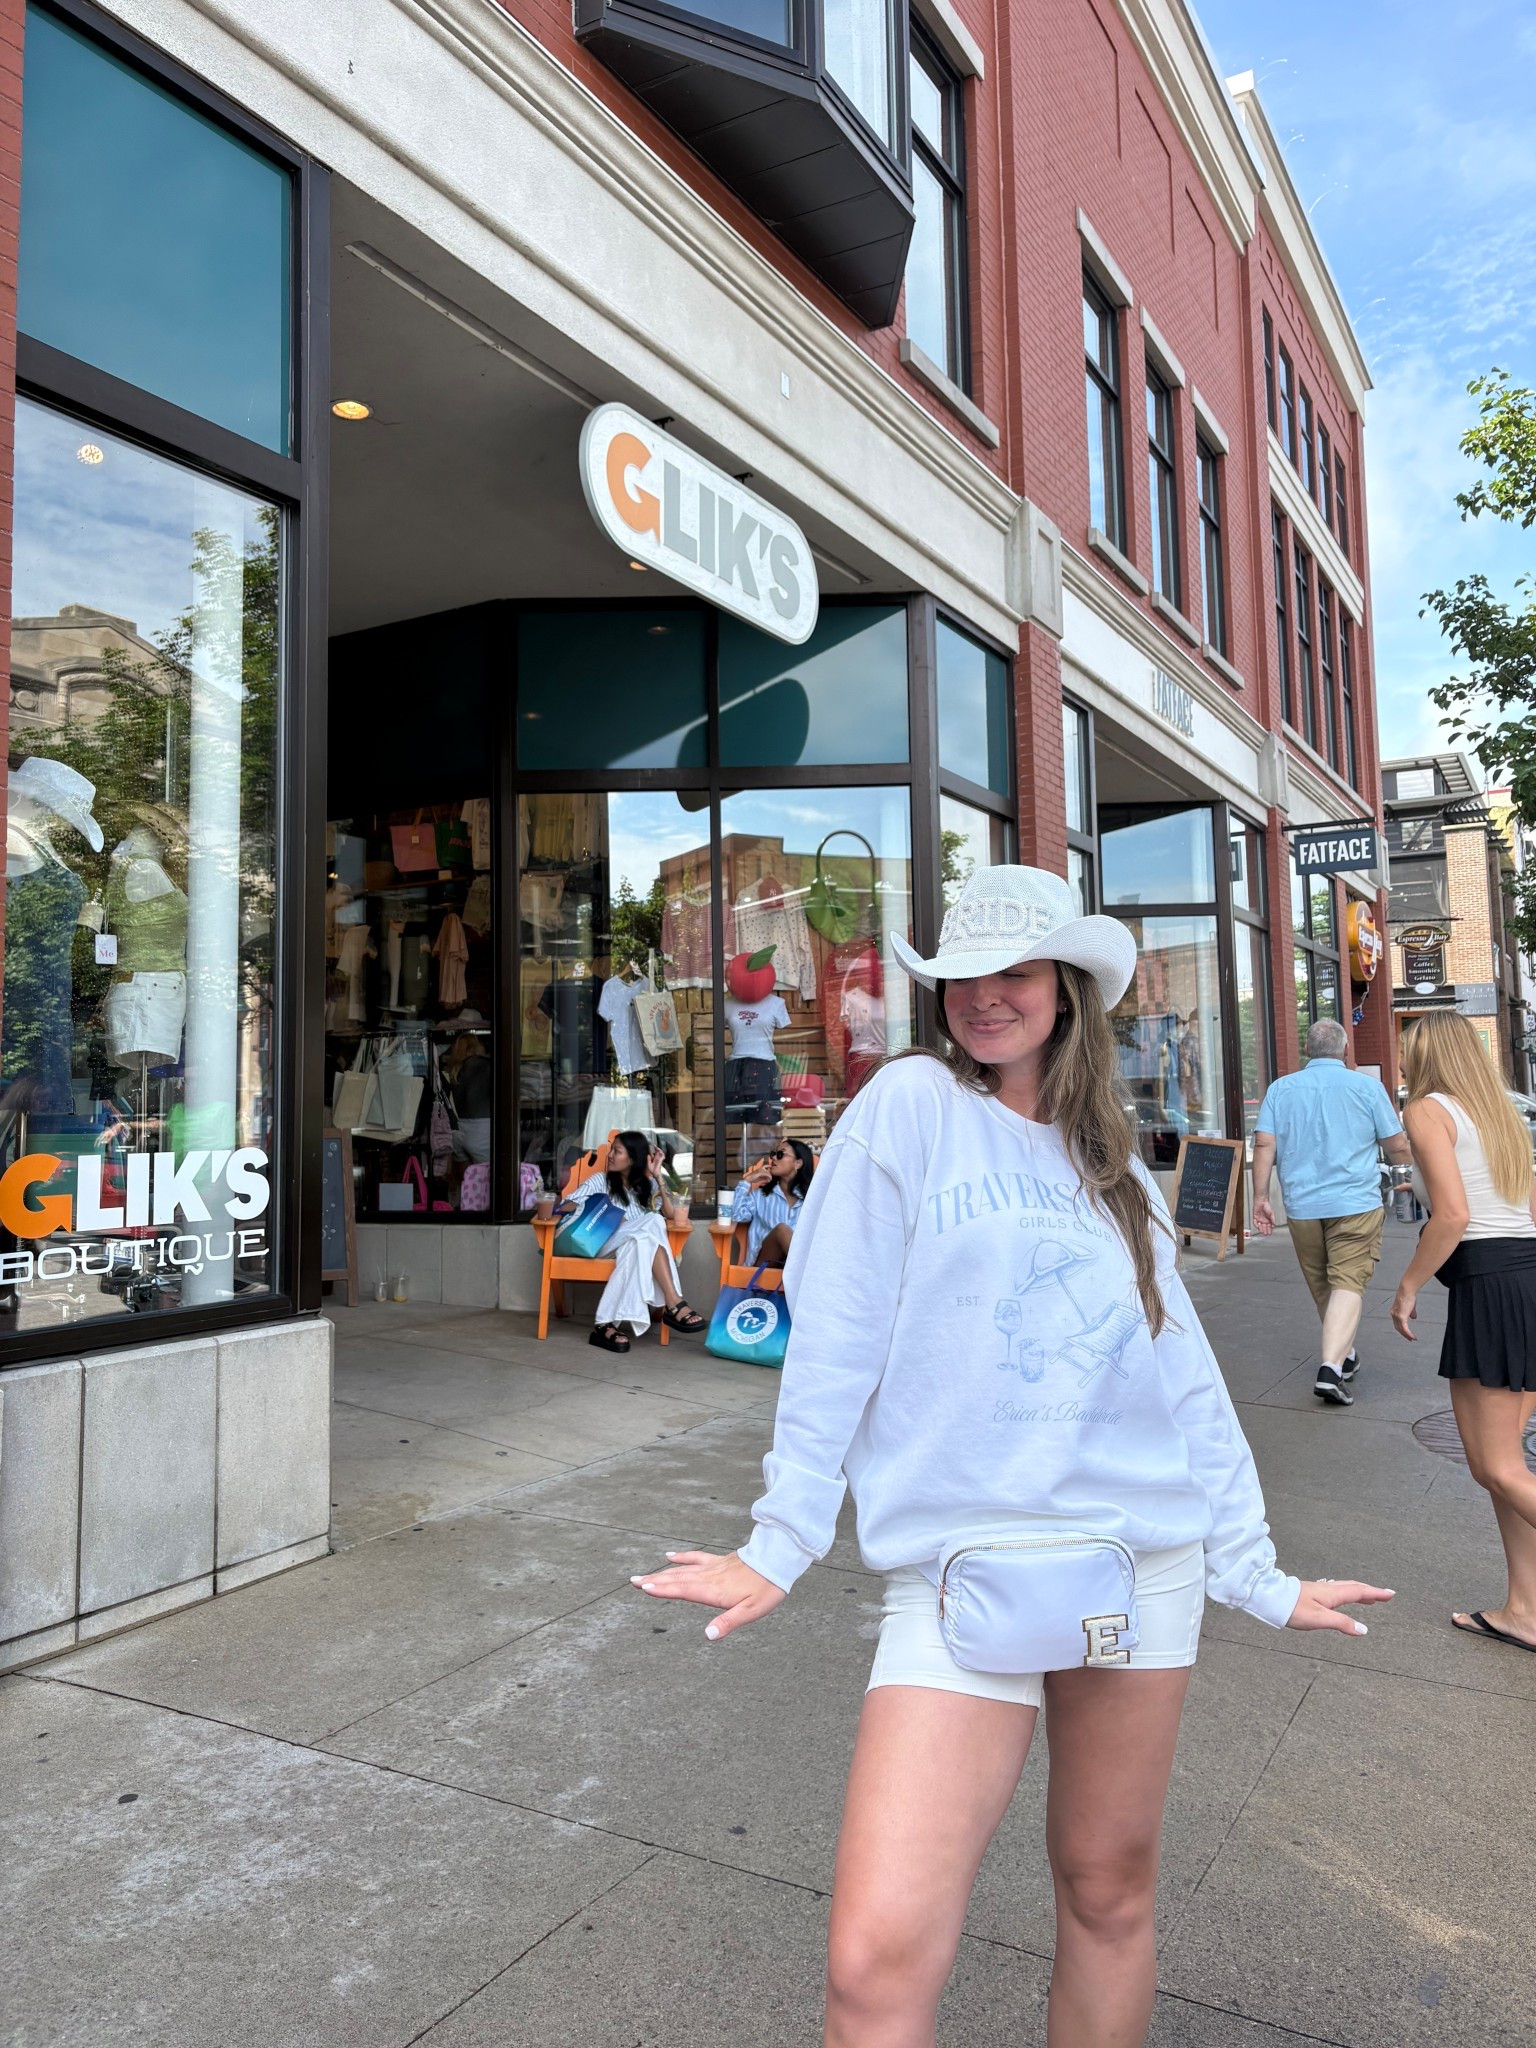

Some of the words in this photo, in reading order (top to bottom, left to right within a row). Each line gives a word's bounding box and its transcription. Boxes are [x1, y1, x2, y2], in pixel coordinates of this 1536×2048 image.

[606, 432, 800, 620] GLIK'S
[1299, 837, 1372, 865] FATFACE
[939, 897, 1053, 944] BRIDE
[1397, 935, 1427, 943] Espresso
[1434, 933, 1449, 942] Bay
[0, 1147, 271, 1239] GLIK'S
[1019, 1216, 1067, 1229] GIRLS
[0, 1228, 270, 1286] BOUTIQUE
[734, 1300, 767, 1314] TRAVERSE
[765, 1305, 776, 1319] CITY
[730, 1327, 766, 1343] MICHIGAN
[993, 1400, 1052, 1423] Erica's
[1081, 1613, 1131, 1666] E
